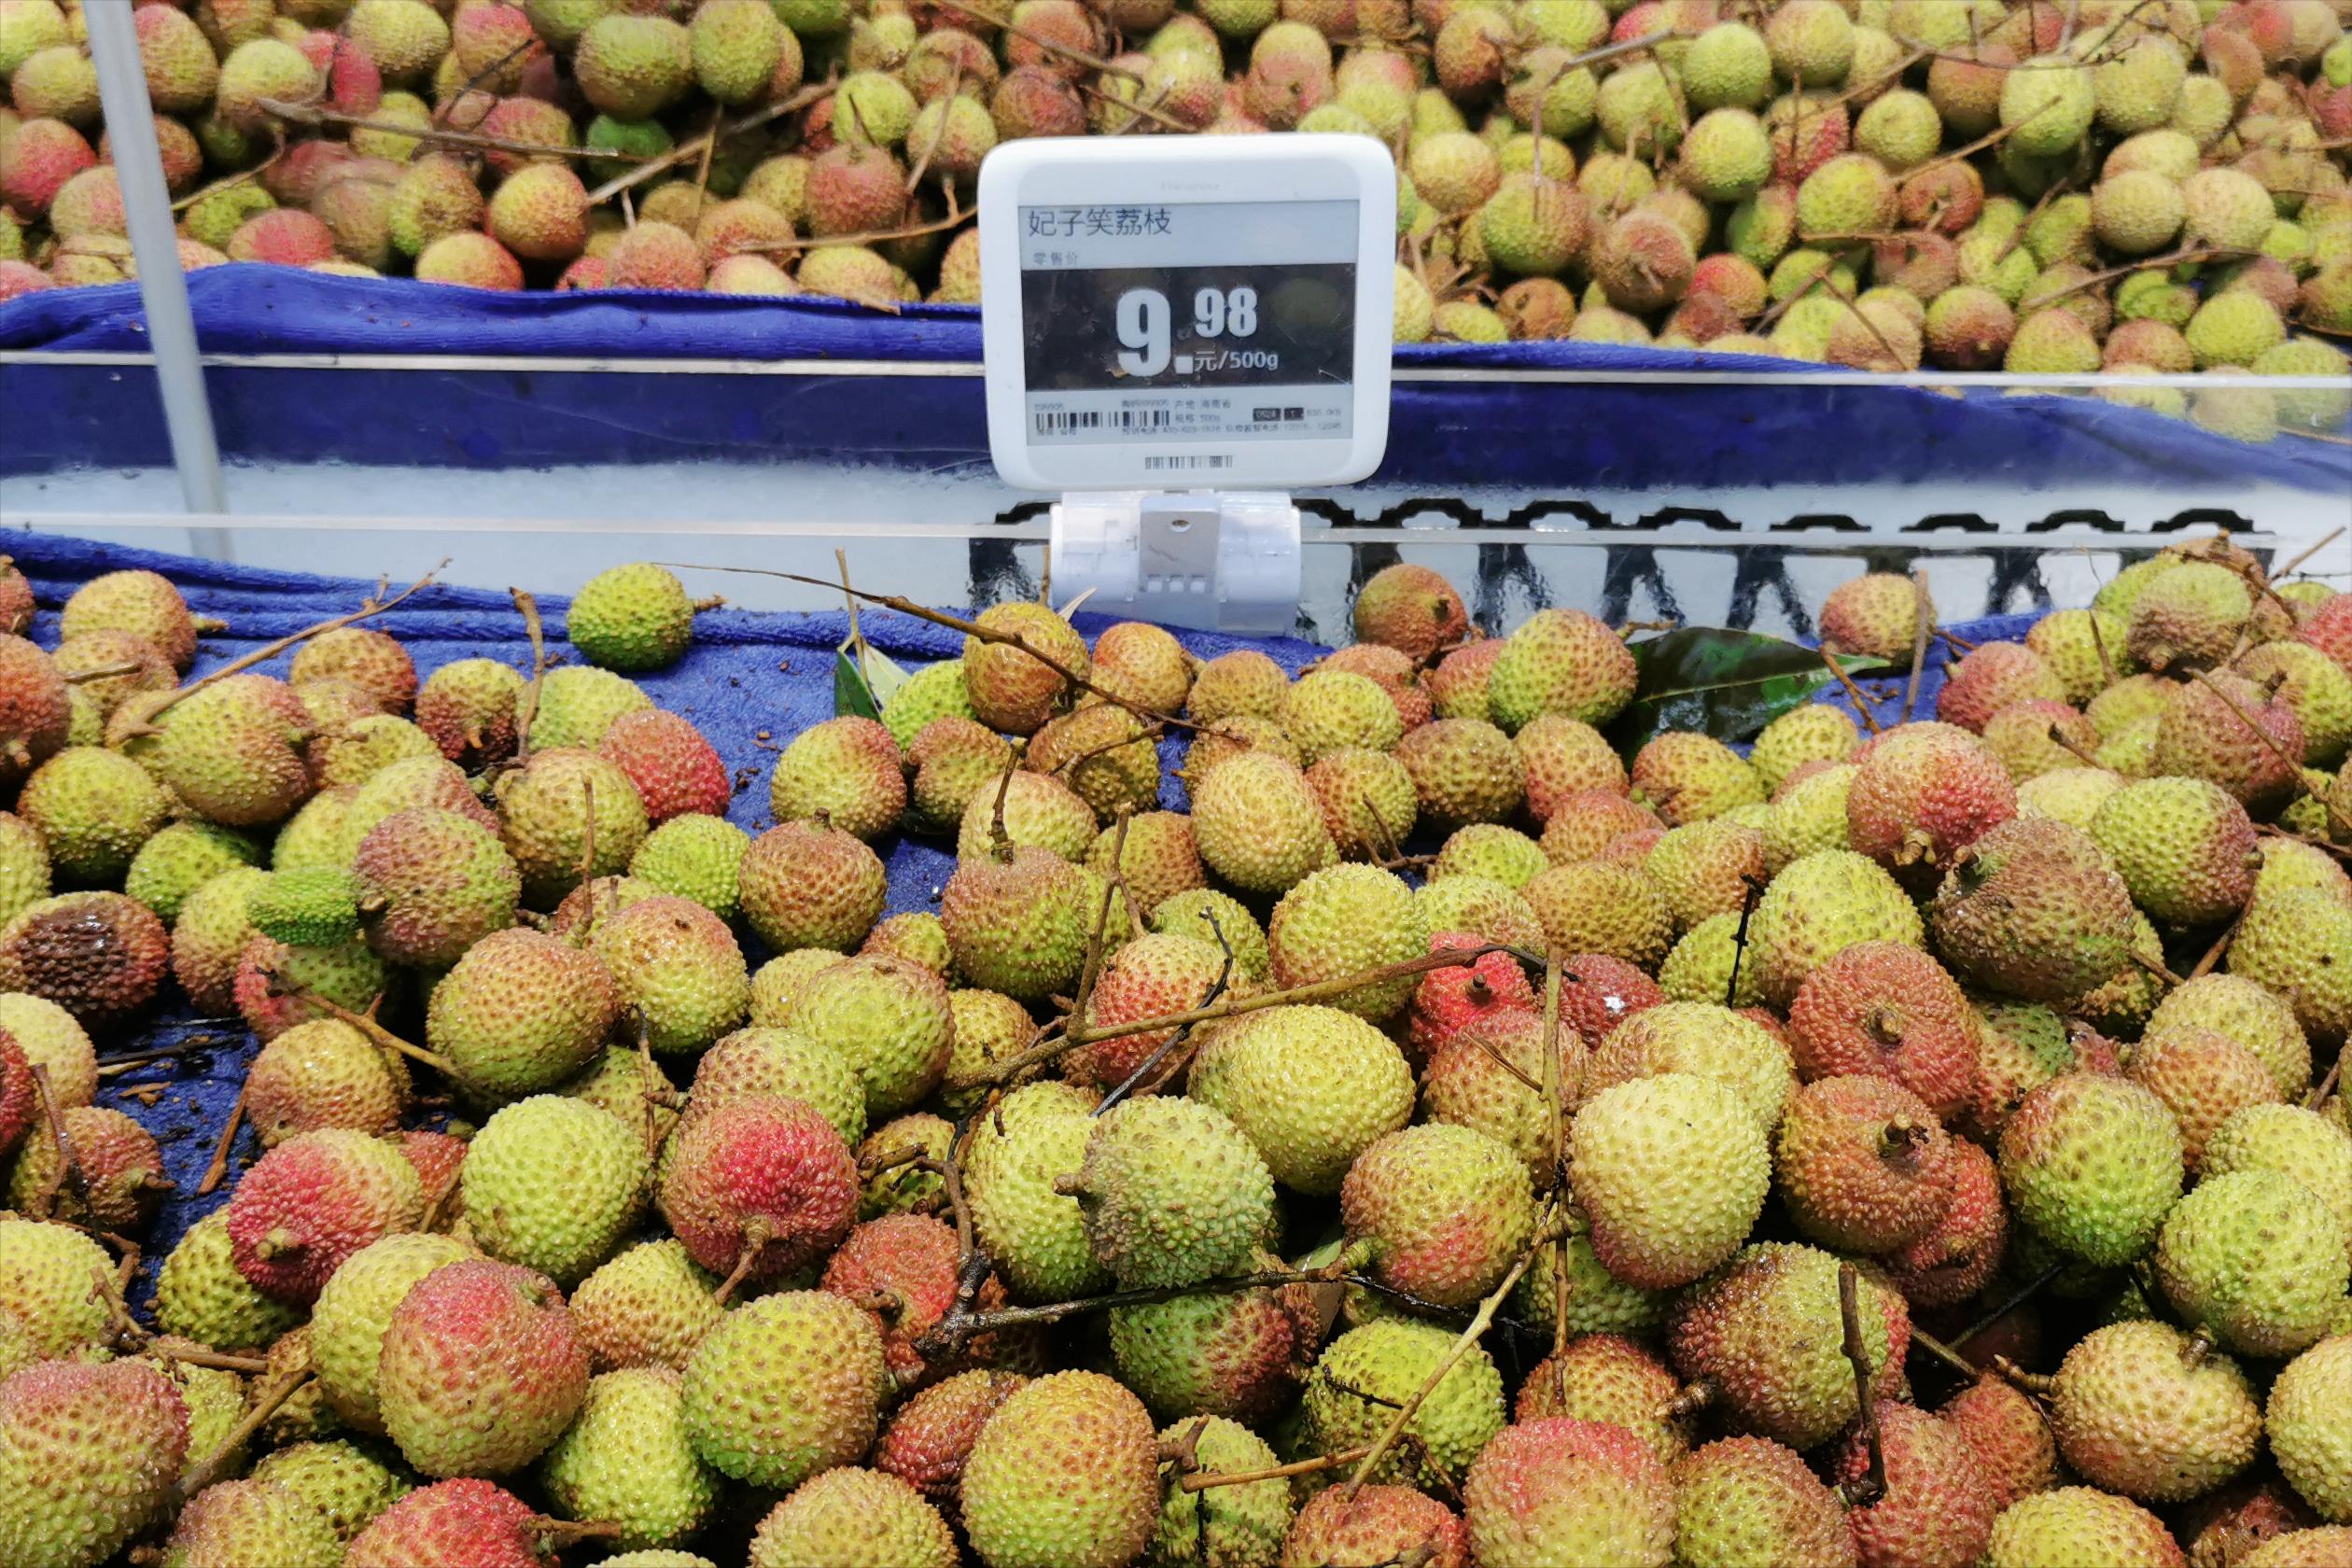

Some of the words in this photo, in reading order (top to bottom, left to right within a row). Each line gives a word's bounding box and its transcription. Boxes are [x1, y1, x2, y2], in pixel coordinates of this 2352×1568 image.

[1028, 208, 1172, 237] 妃子笑荔枝
[1033, 252, 1078, 266] 零售价
[1194, 351, 1279, 371] 元/500g
